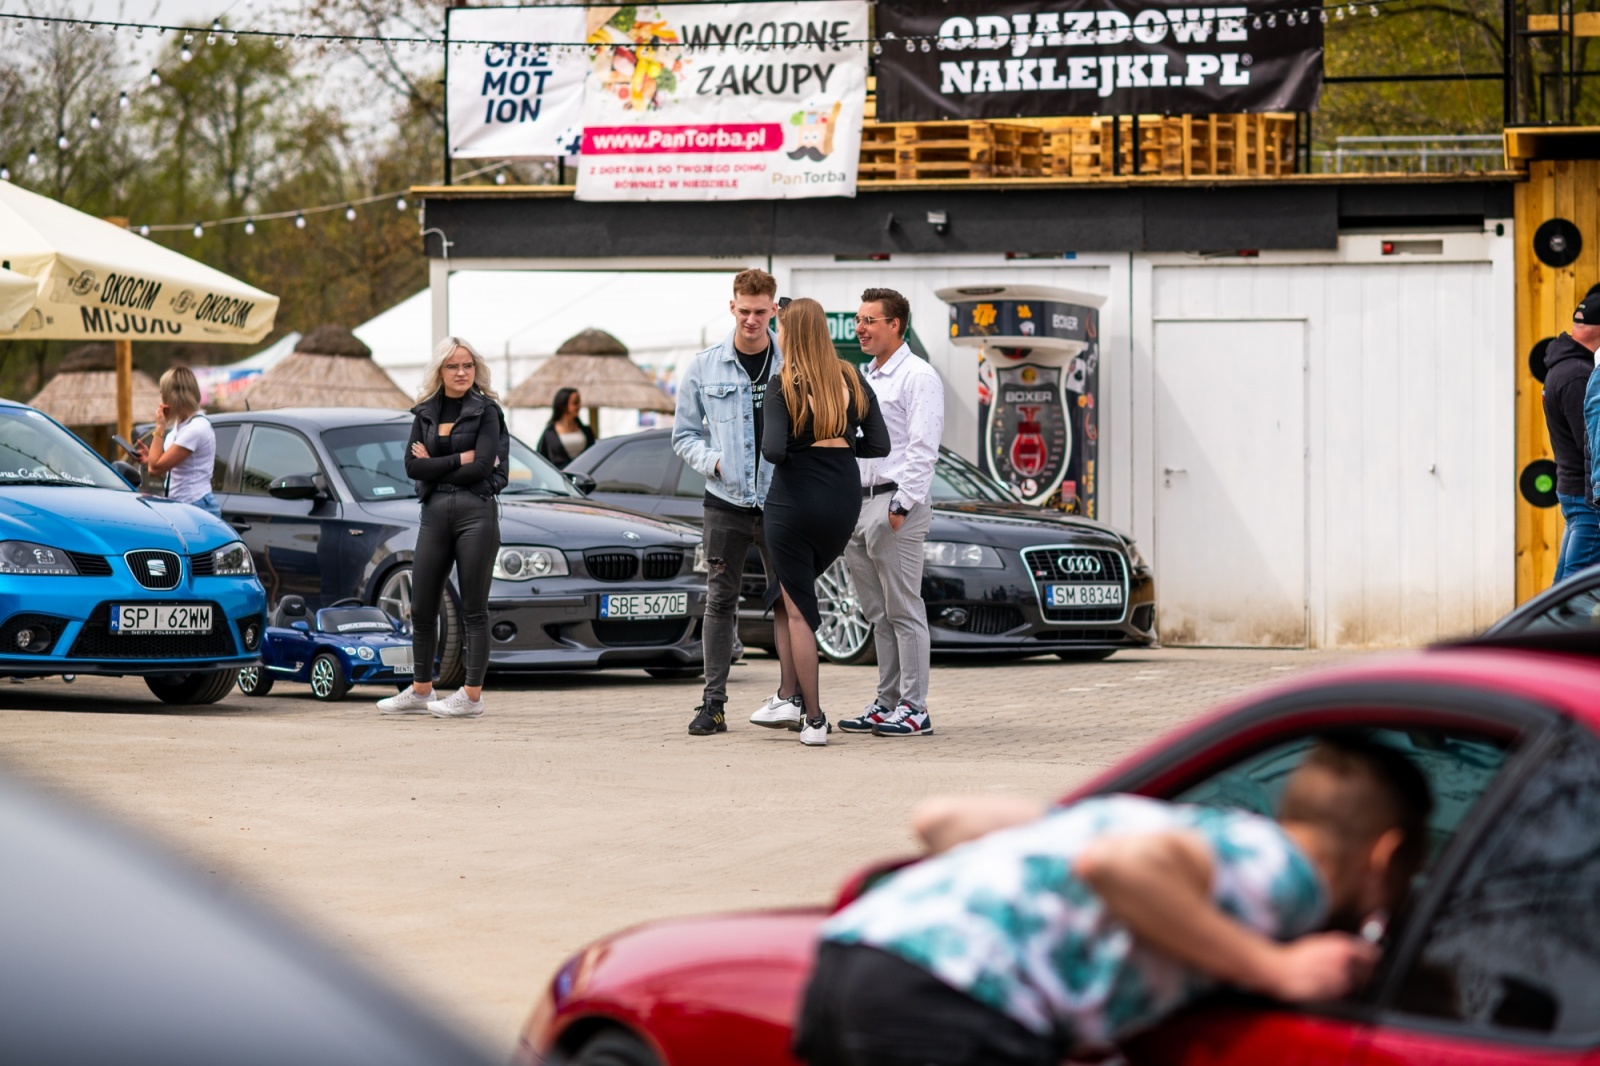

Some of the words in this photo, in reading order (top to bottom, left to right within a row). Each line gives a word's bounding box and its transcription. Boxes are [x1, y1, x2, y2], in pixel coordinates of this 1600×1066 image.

[681, 20, 850, 53] WYGODNE
[938, 7, 1248, 56] ODJAZDOWE
[481, 71, 553, 96] MOT
[696, 63, 835, 95] ZAKUPY
[940, 53, 1250, 97] NAKLEJKI.PL
[485, 98, 541, 124] ION
[592, 128, 767, 150] www.PanTorba.pl
[657, 164, 672, 174] DO
[676, 163, 731, 174] TWOJEGO
[734, 163, 767, 173] DOMU
[771, 170, 847, 185] PanTorba
[101, 273, 162, 311] OKOCIM
[195, 292, 255, 329] OKOCIM
[1052, 313, 1079, 331] BOXER
[1005, 391, 1052, 403] BOXER
[609, 597, 639, 615] SBE
[644, 594, 685, 614] 5670E
[1055, 587, 1076, 604] SM
[1080, 586, 1120, 604] 88344
[123, 608, 158, 629] SPI
[168, 608, 210, 629] 62WM
